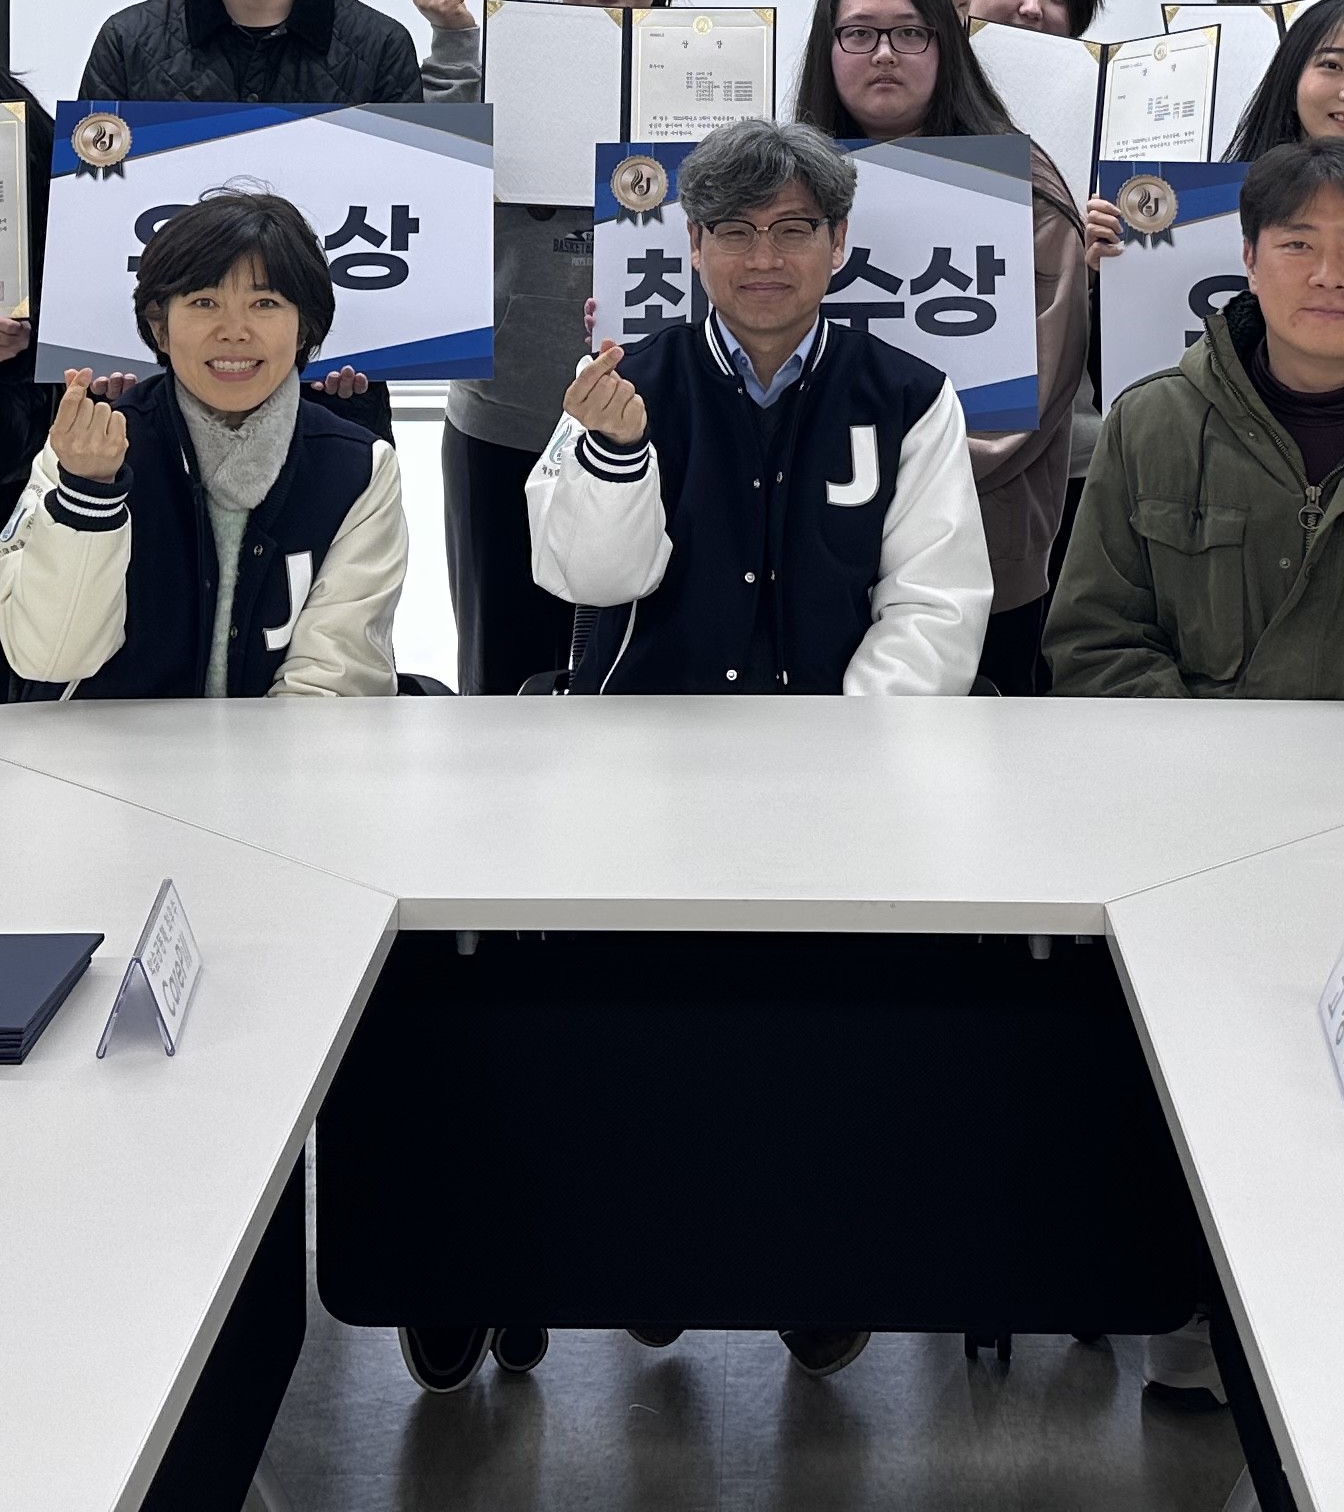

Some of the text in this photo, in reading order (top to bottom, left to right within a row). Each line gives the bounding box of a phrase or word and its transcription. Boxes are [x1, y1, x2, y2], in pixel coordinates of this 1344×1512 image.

[622, 245, 1006, 337] 최수상
[825, 424, 881, 508] J
[262, 551, 312, 651] J
